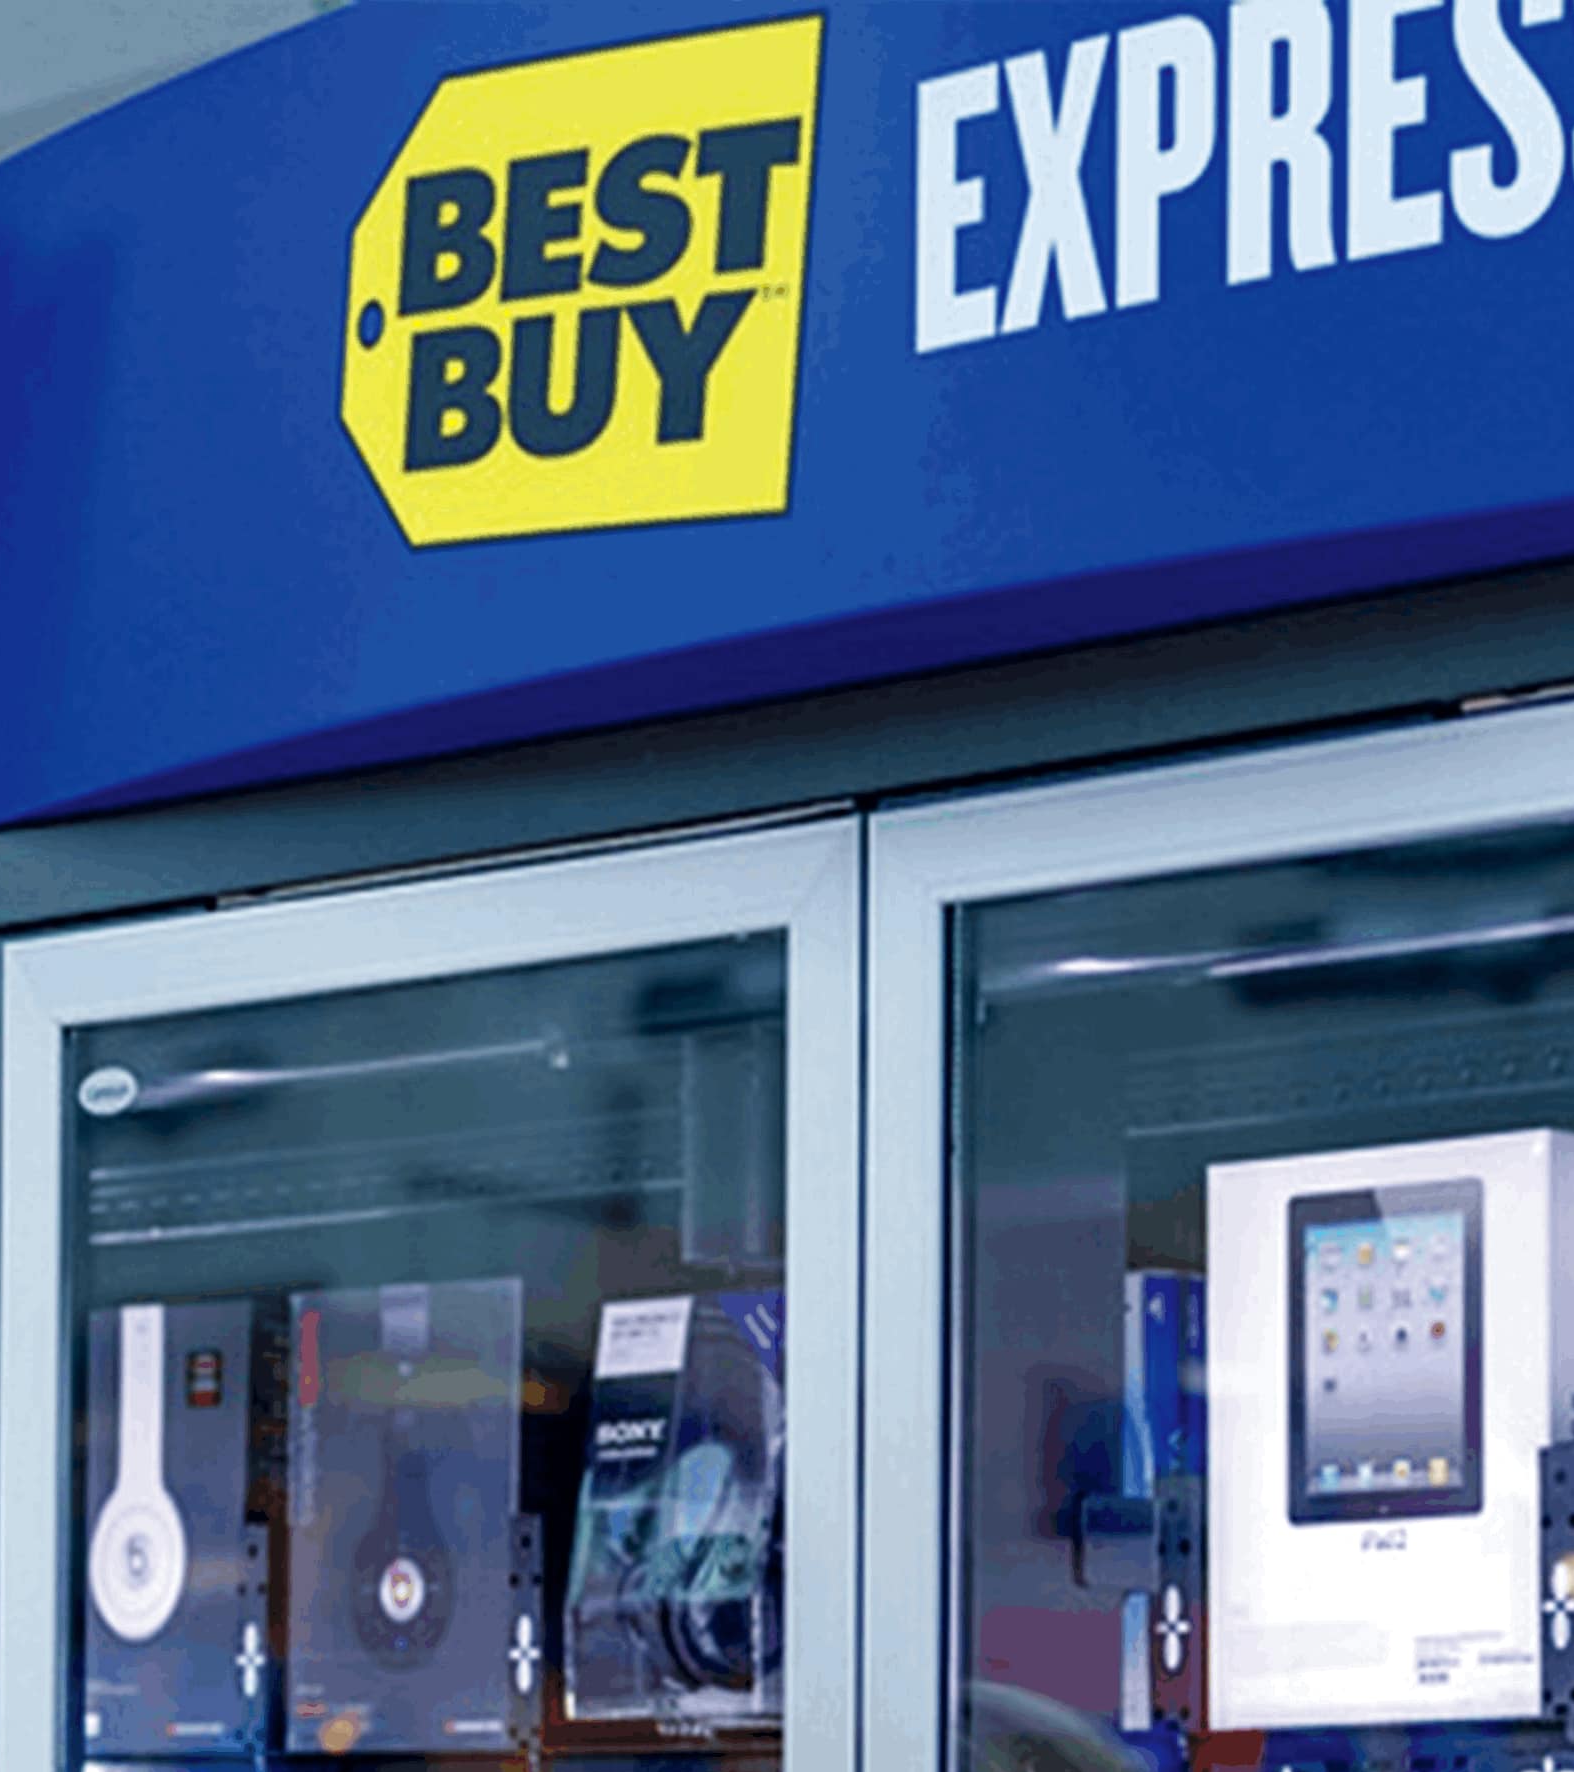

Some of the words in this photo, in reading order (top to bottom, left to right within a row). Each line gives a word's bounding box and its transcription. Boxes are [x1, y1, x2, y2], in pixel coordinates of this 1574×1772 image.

[396, 115, 803, 319] BEST
[402, 287, 758, 474] BUY
[596, 1417, 667, 1446] SONY
